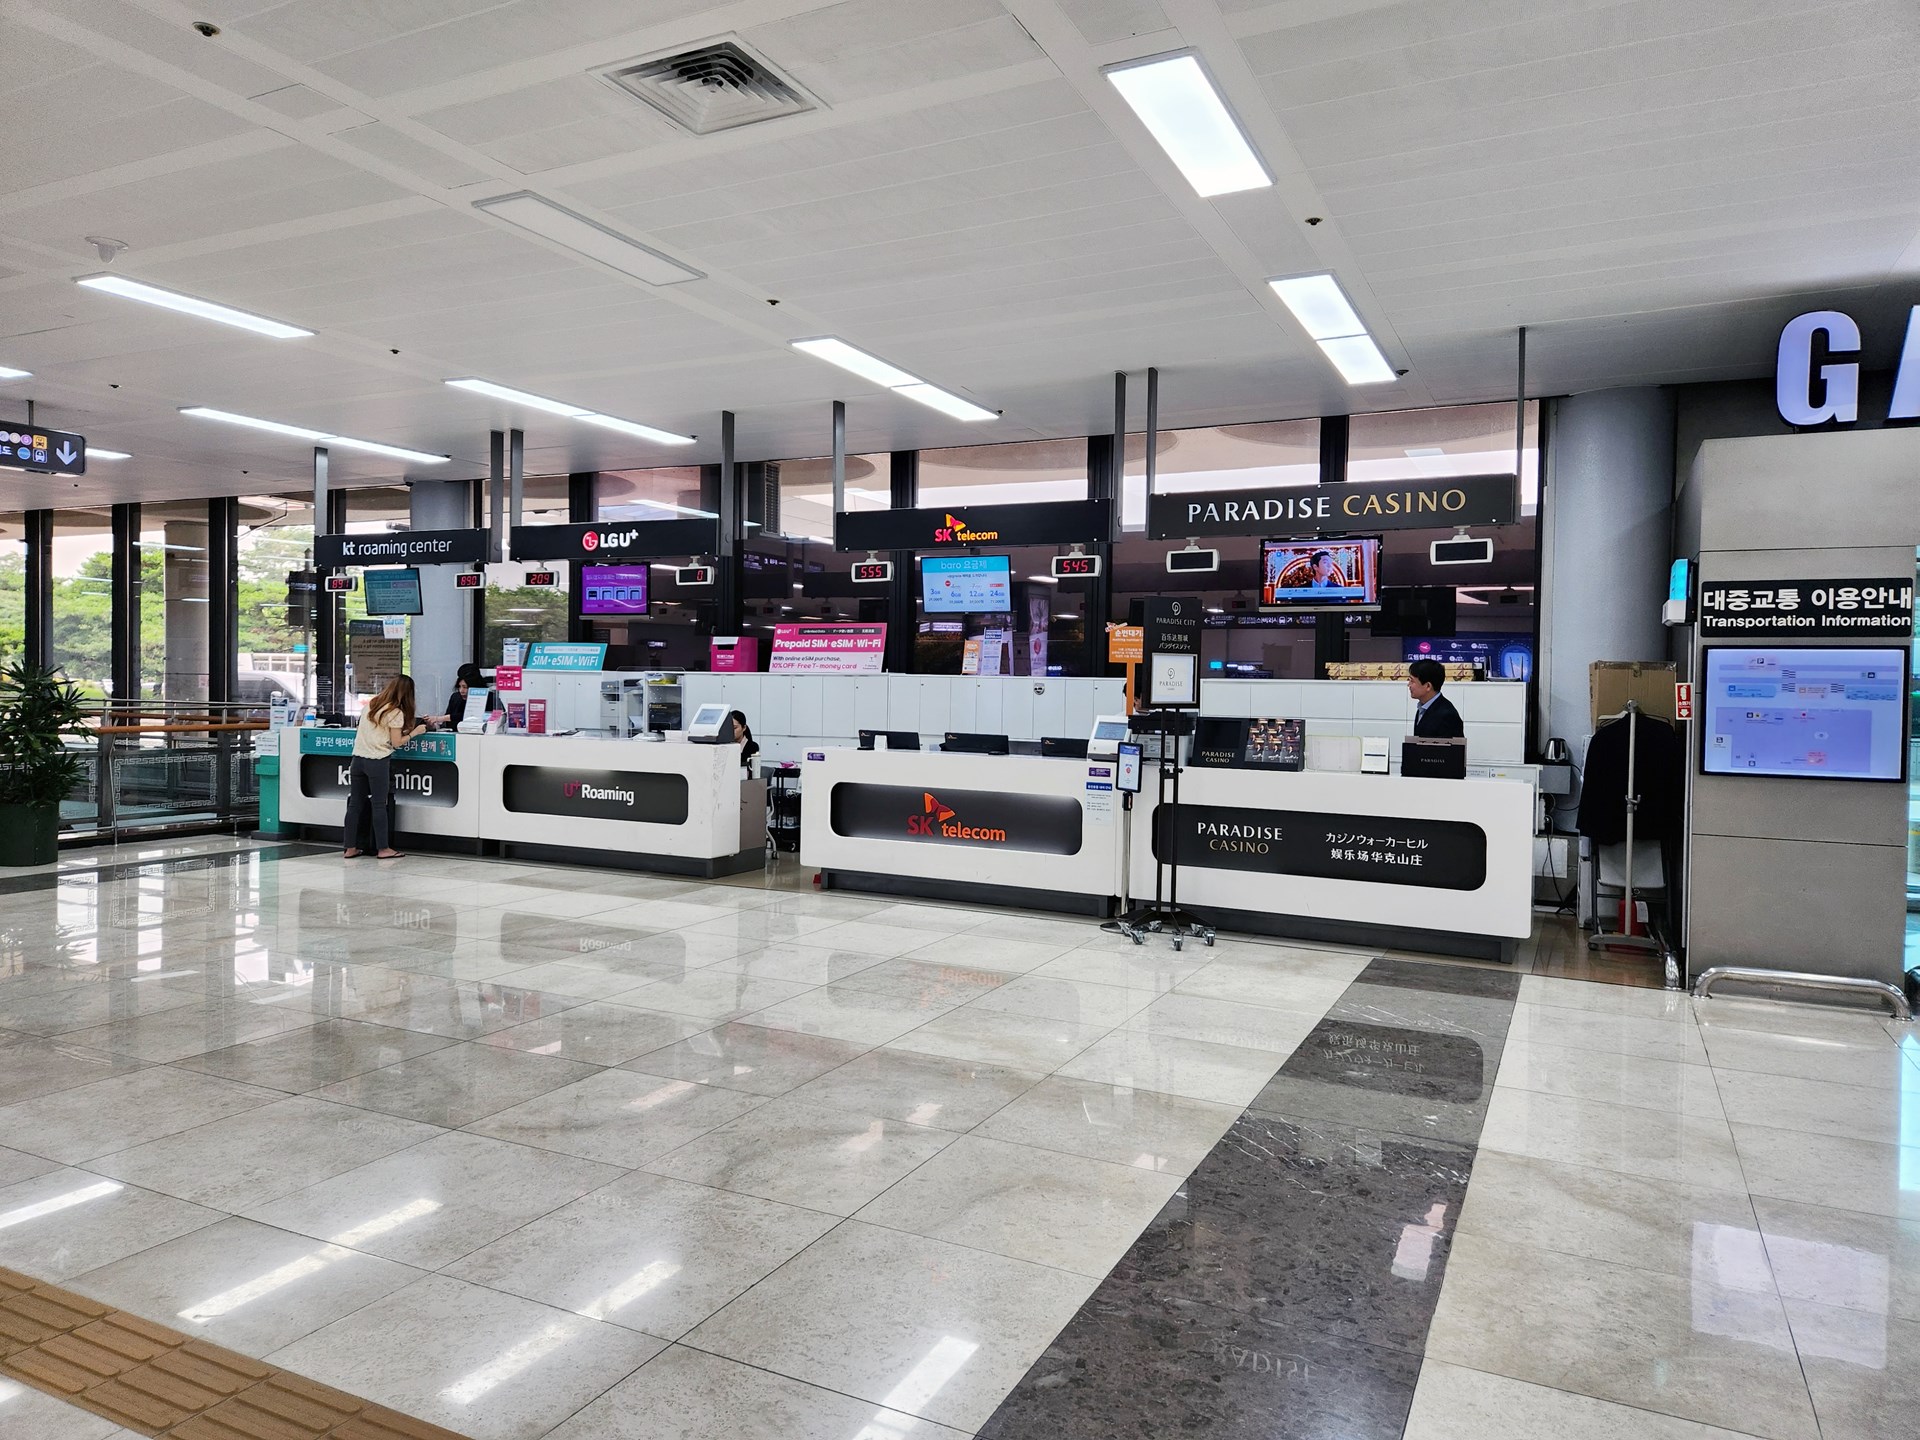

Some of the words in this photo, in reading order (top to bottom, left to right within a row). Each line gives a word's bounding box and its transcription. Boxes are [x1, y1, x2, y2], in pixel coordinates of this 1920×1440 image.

[0, 444, 13, 455] 도
[1187, 496, 1331, 523] PARADISE
[1342, 489, 1467, 517] CASINO
[600, 529, 639, 548] LGU+
[935, 528, 953, 542] SK
[957, 529, 998, 541] telecom
[342, 541, 356, 556] kt
[358, 540, 407, 557] roaming
[409, 538, 453, 553] center
[860, 566, 882, 578] 555
[941, 561, 962, 569] baro
[963, 560, 987, 570] 요금제
[1063, 560, 1089, 573] 545
[331, 579, 349, 589] 891
[461, 576, 477, 586] 890
[530, 574, 550, 584] 209
[1703, 588, 1801, 611] 대중교통
[1811, 586, 1912, 610] 이용안내
[1156, 617, 1182, 625] PARADISE
[1703, 615, 1816, 628] Transportation
[1821, 614, 1911, 627] Information
[1115, 629, 1143, 637] 순번대기
[774, 639, 810, 650] Prepaid
[420, 740, 437, 752] 함께
[563, 780, 581, 797] U+
[581, 784, 635, 806] Roaming
[907, 815, 934, 836] SK
[941, 821, 1007, 842] telecom
[1197, 822, 1284, 841] PARADISE
[1208, 838, 1270, 855] CASINO
[1325, 832, 1429, 850] カジノウォーカーヒル
[1330, 848, 1424, 867] 娱乐场华克山庄
